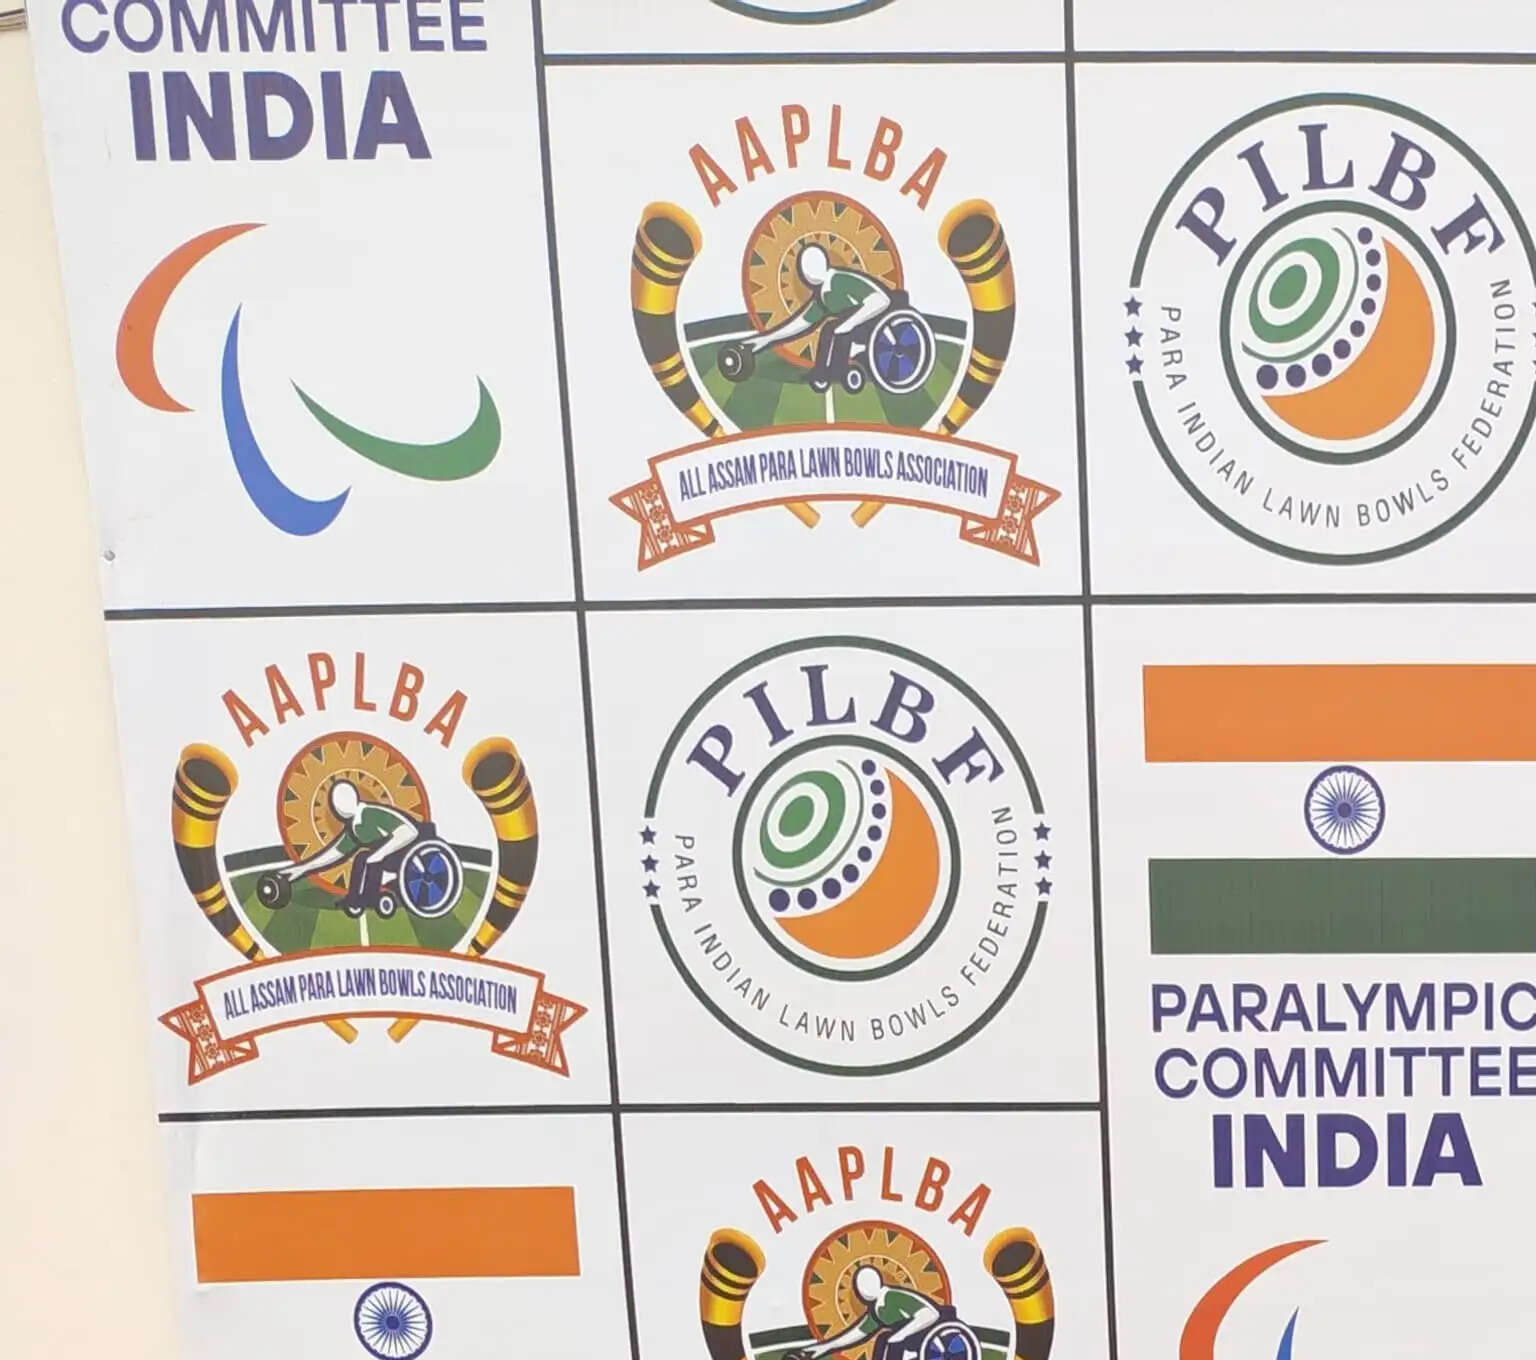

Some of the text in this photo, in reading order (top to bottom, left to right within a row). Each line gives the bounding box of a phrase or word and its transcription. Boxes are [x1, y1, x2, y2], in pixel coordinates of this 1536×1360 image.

[62, 0, 487, 52] COMMITTEE
[129, 71, 431, 160] INDIA
[689, 104, 947, 211] AAPLBA
[1175, 124, 1506, 266] PILBF
[1160, 279, 1516, 527] PARA INDIAN LAWN BOWLS FEDERATION
[679, 447, 988, 501] ALL ASSAM PARA LAWN BOWLS ASSOCIATION
[222, 651, 468, 748] AAPLBA
[686, 664, 1005, 797] PILBF
[675, 806, 1019, 1041] PARA INDIAN LAWN BOWLS FEDERATION
[224, 968, 516, 1020] ALL ASSAM PARA LAWN BOWLS ASSOCIATION
[752, 1146, 991, 1237] AAPLBA
[1213, 1113, 1482, 1188] INDIA
